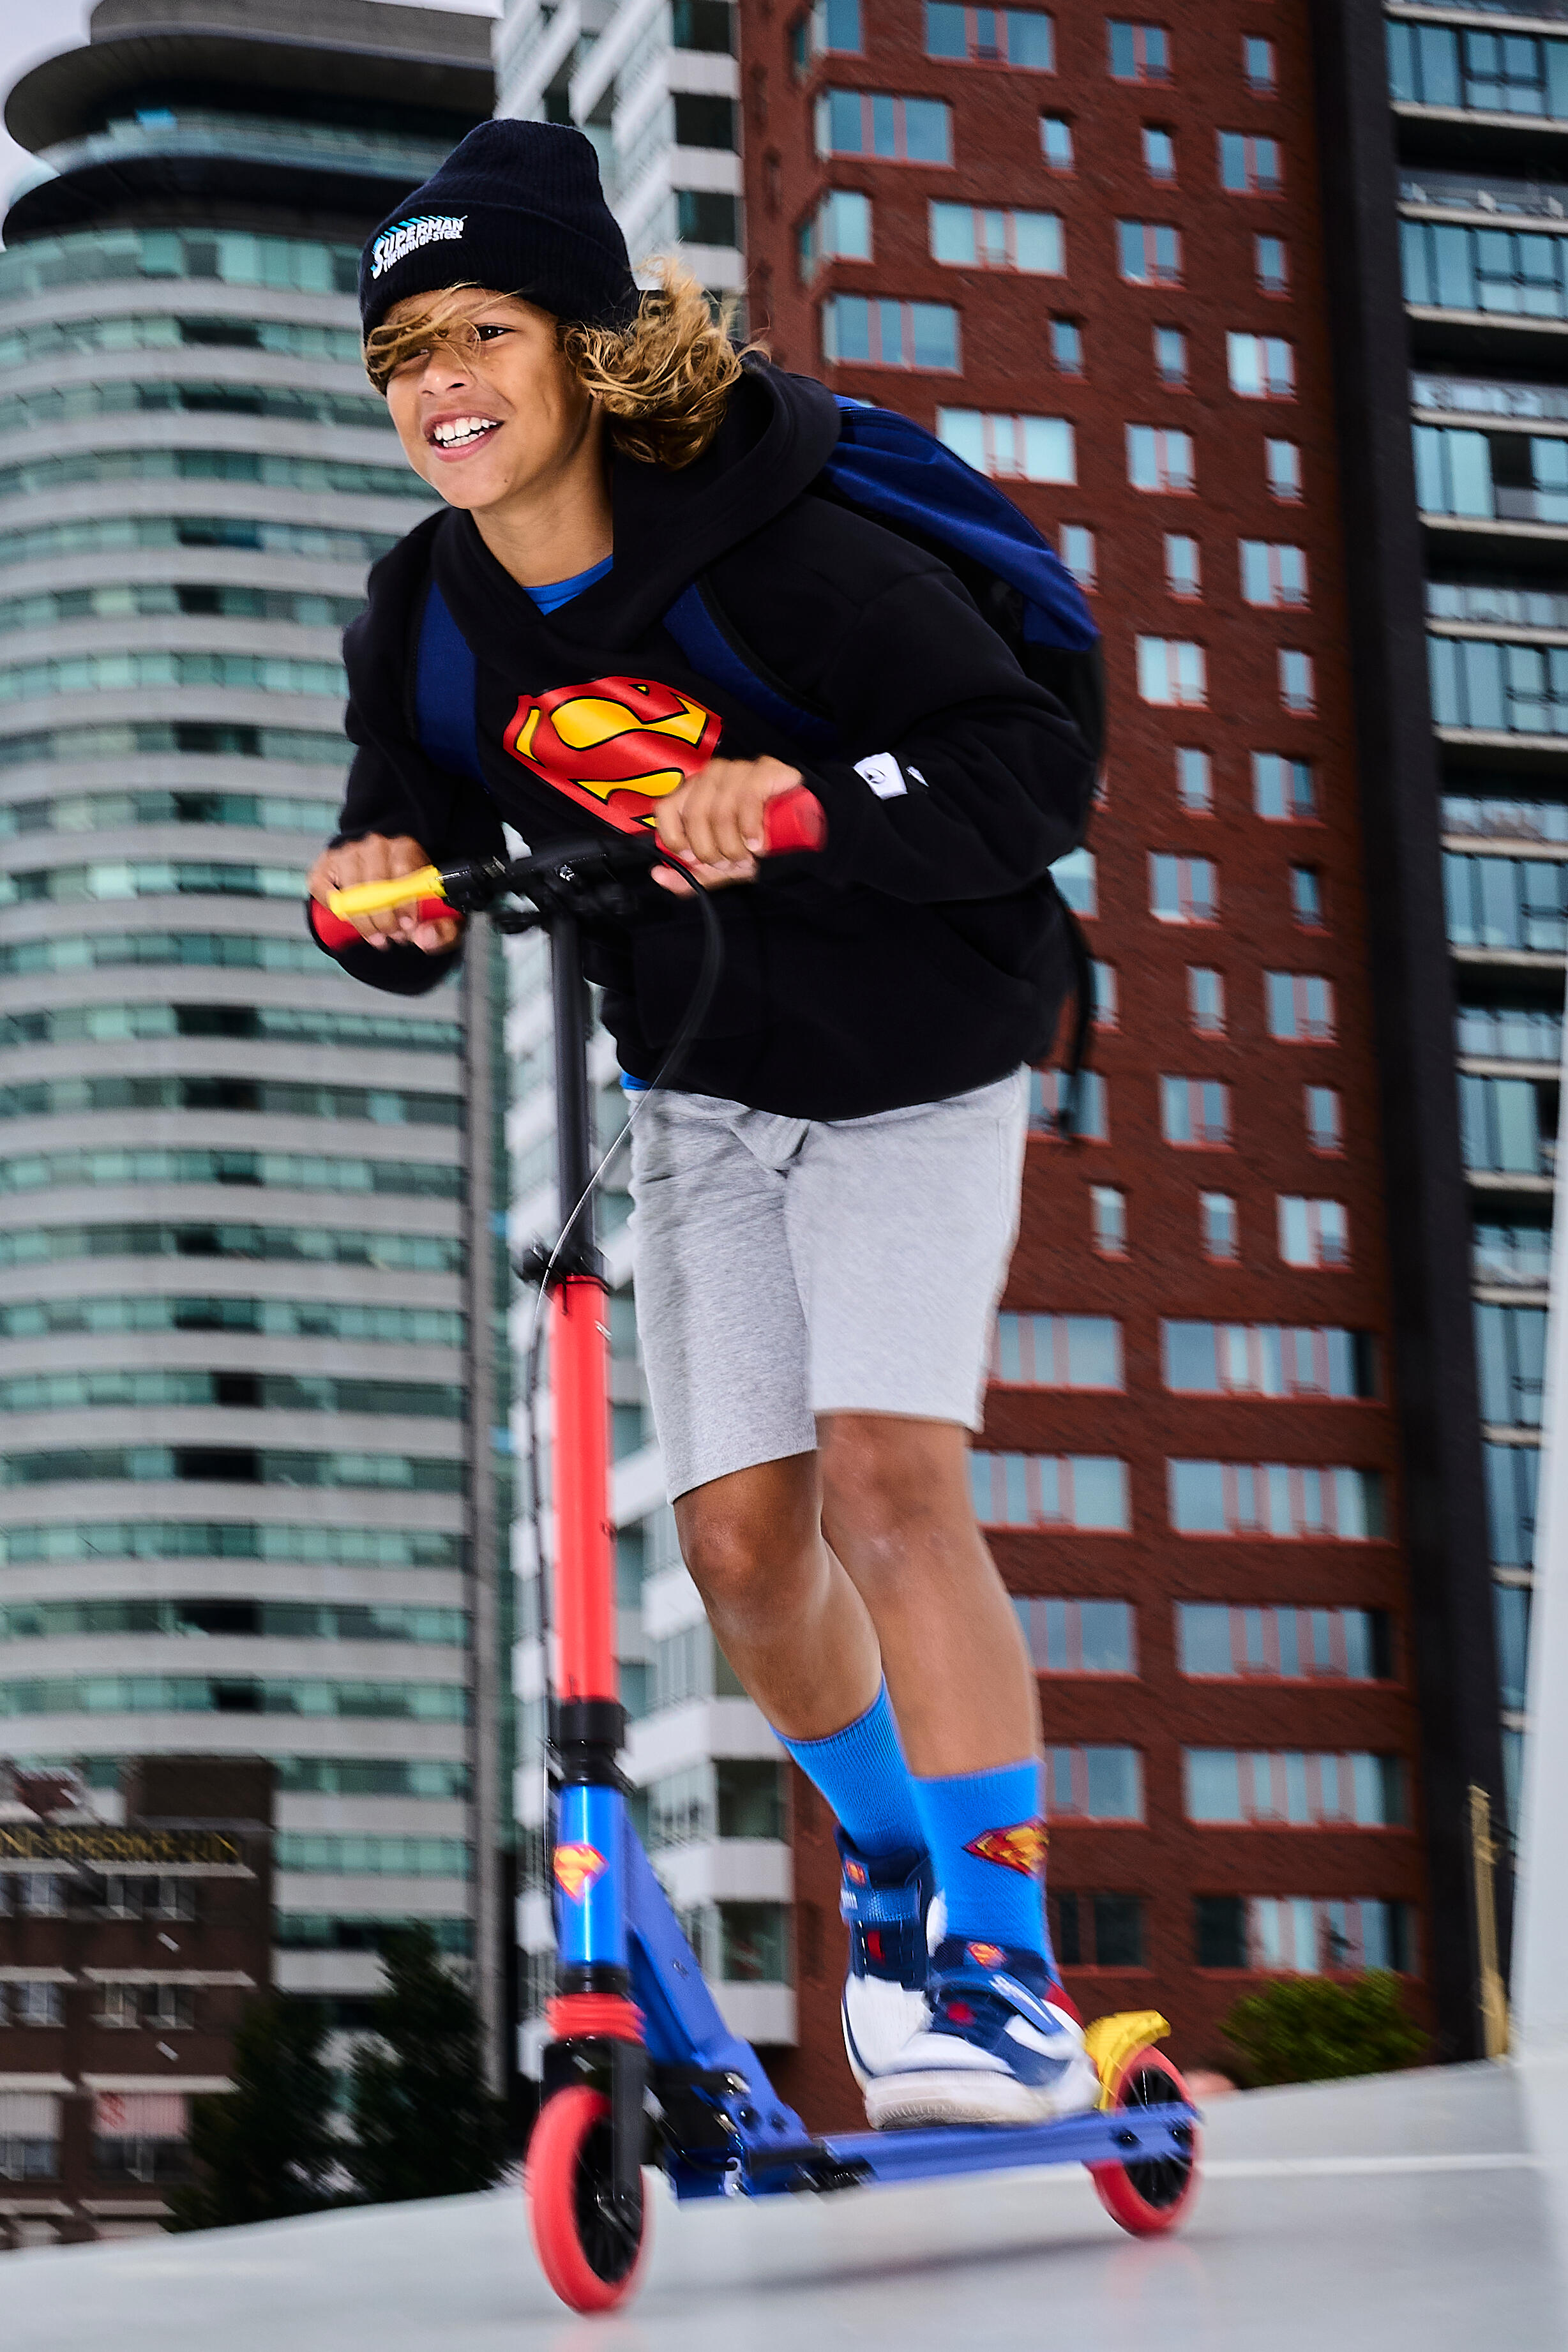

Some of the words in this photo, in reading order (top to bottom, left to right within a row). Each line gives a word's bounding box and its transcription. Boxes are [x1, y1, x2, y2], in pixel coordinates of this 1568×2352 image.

[372, 216, 467, 279] SUPERMAN
[382, 250, 397, 273] THE
[395, 239, 419, 260] MAN
[419, 234, 432, 246] OF
[433, 230, 462, 241] STEEL
